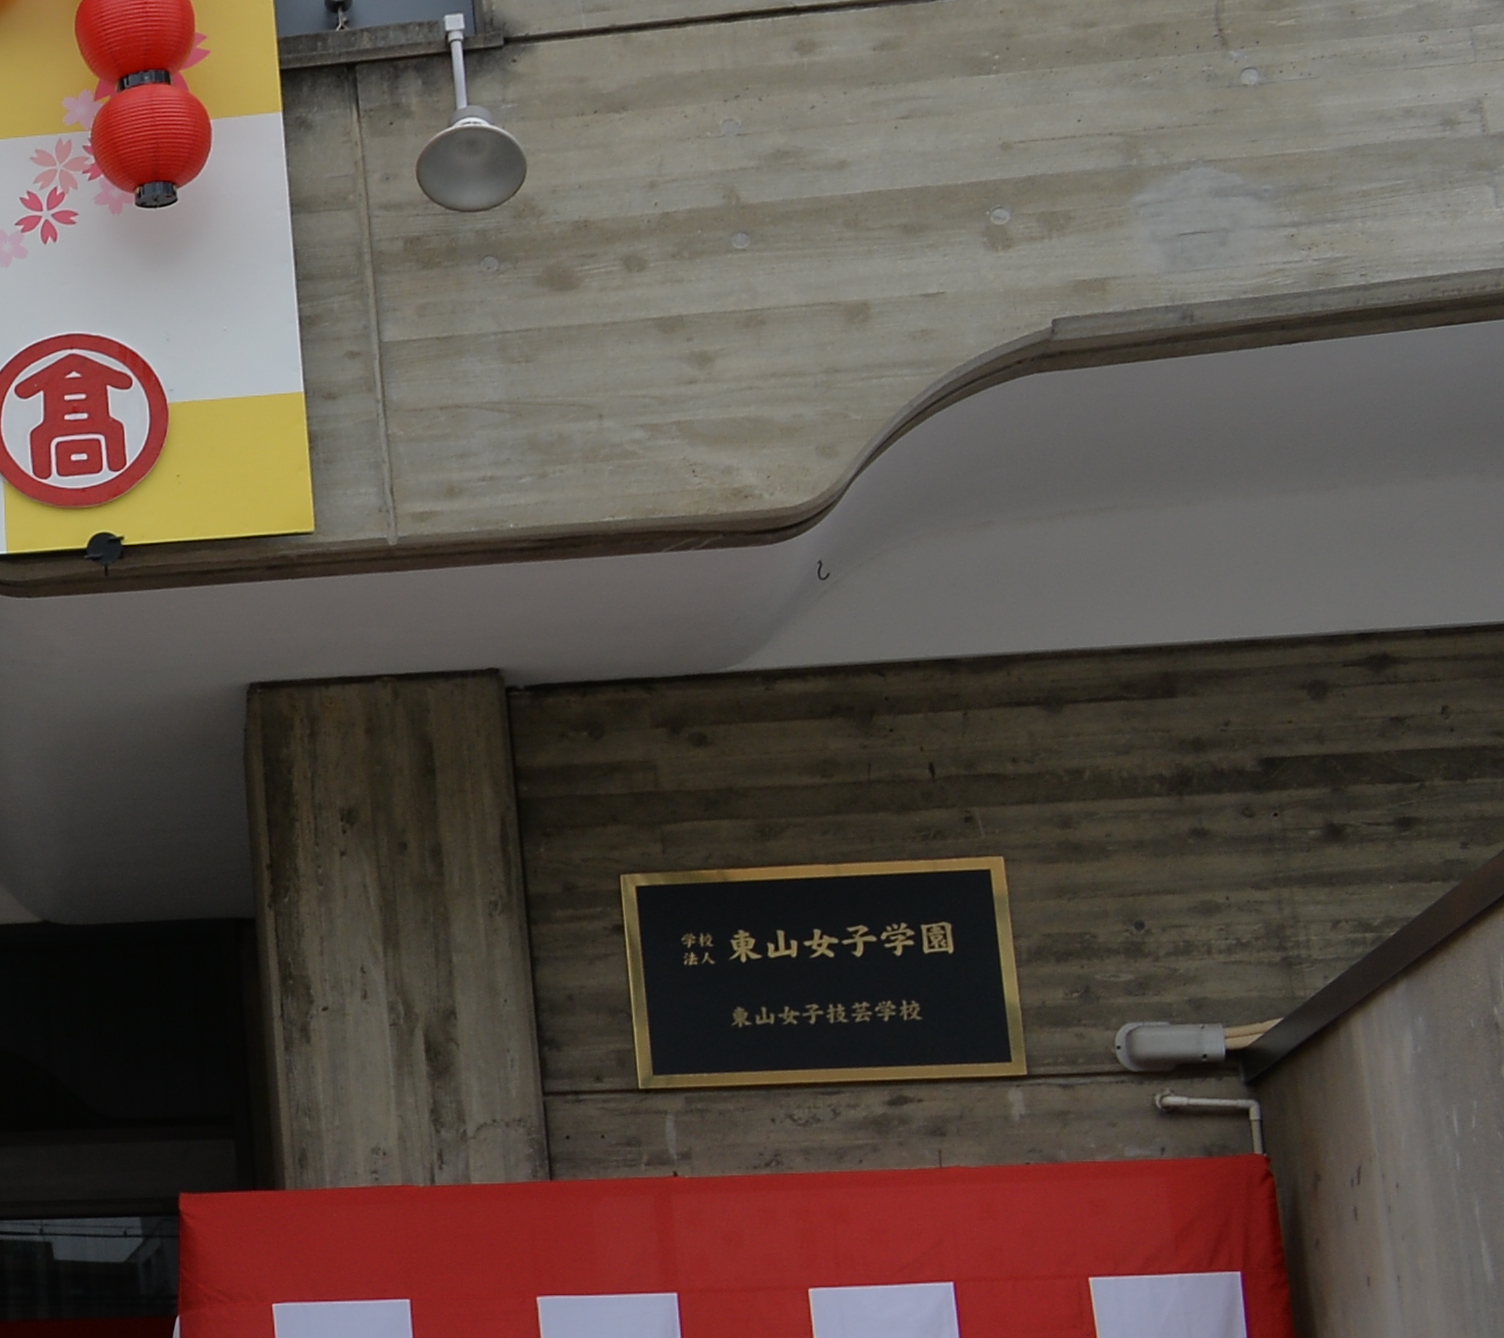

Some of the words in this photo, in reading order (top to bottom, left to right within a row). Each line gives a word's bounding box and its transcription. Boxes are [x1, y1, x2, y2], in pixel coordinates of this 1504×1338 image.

[728, 920, 955, 963] 東山女子学園
[731, 999, 924, 1029] 東山女子技芸学校
